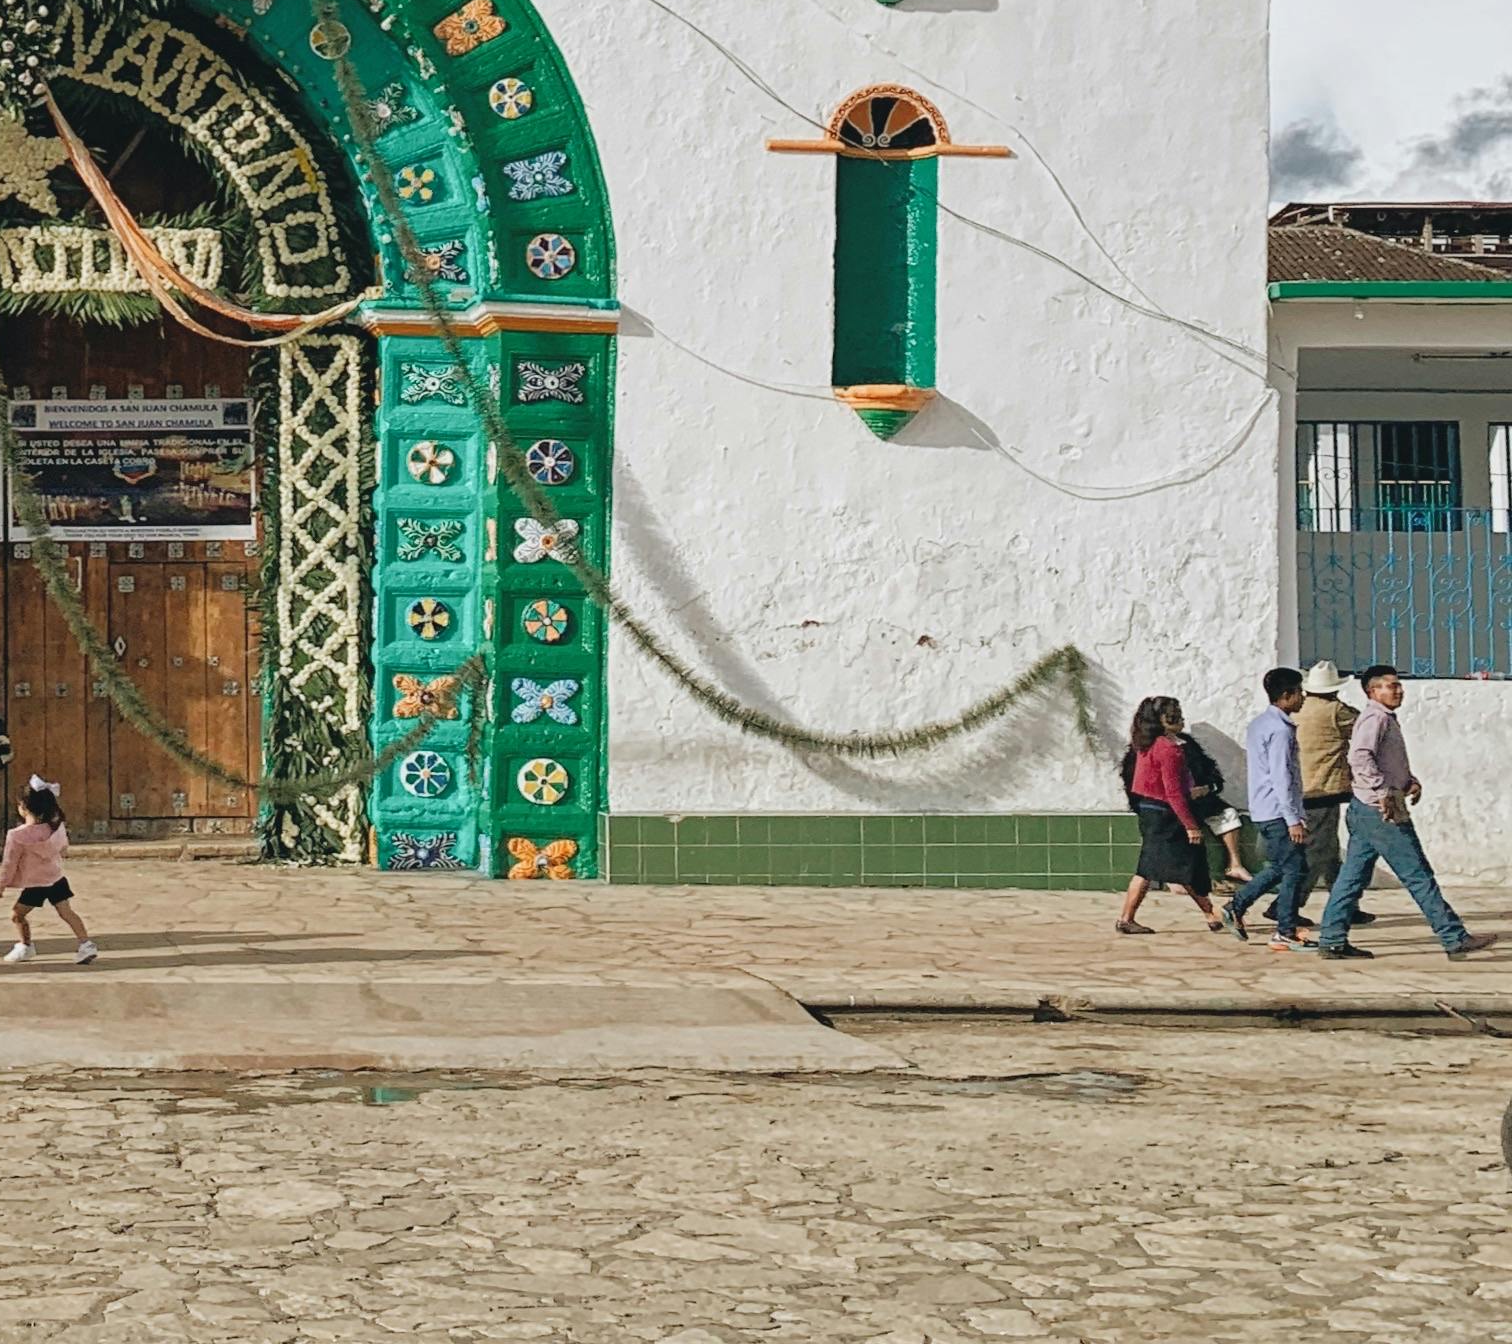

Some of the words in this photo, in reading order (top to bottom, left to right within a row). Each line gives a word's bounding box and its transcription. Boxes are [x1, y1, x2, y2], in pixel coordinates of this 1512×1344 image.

[44, 405, 108, 413] BIENVENIDOS
[142, 404, 166, 412] JUAN
[169, 404, 218, 412] CHAMULA
[49, 420, 96, 429] WELCOME
[100, 420, 112, 428] TO
[115, 420, 135, 428] SAN
[138, 419, 165, 428] JUAN
[166, 419, 214, 428] CHAMULA
[29, 439, 60, 447] USTED
[62, 439, 93, 447] DESEA
[96, 439, 116, 447] UNA
[19, 448, 60, 456] NTERIOR
[64, 448, 76, 456] DE
[81, 448, 94, 456] LA
[21, 457, 55, 465] OLETA
[56, 457, 68, 465] EN
[70, 457, 83, 465] LA
